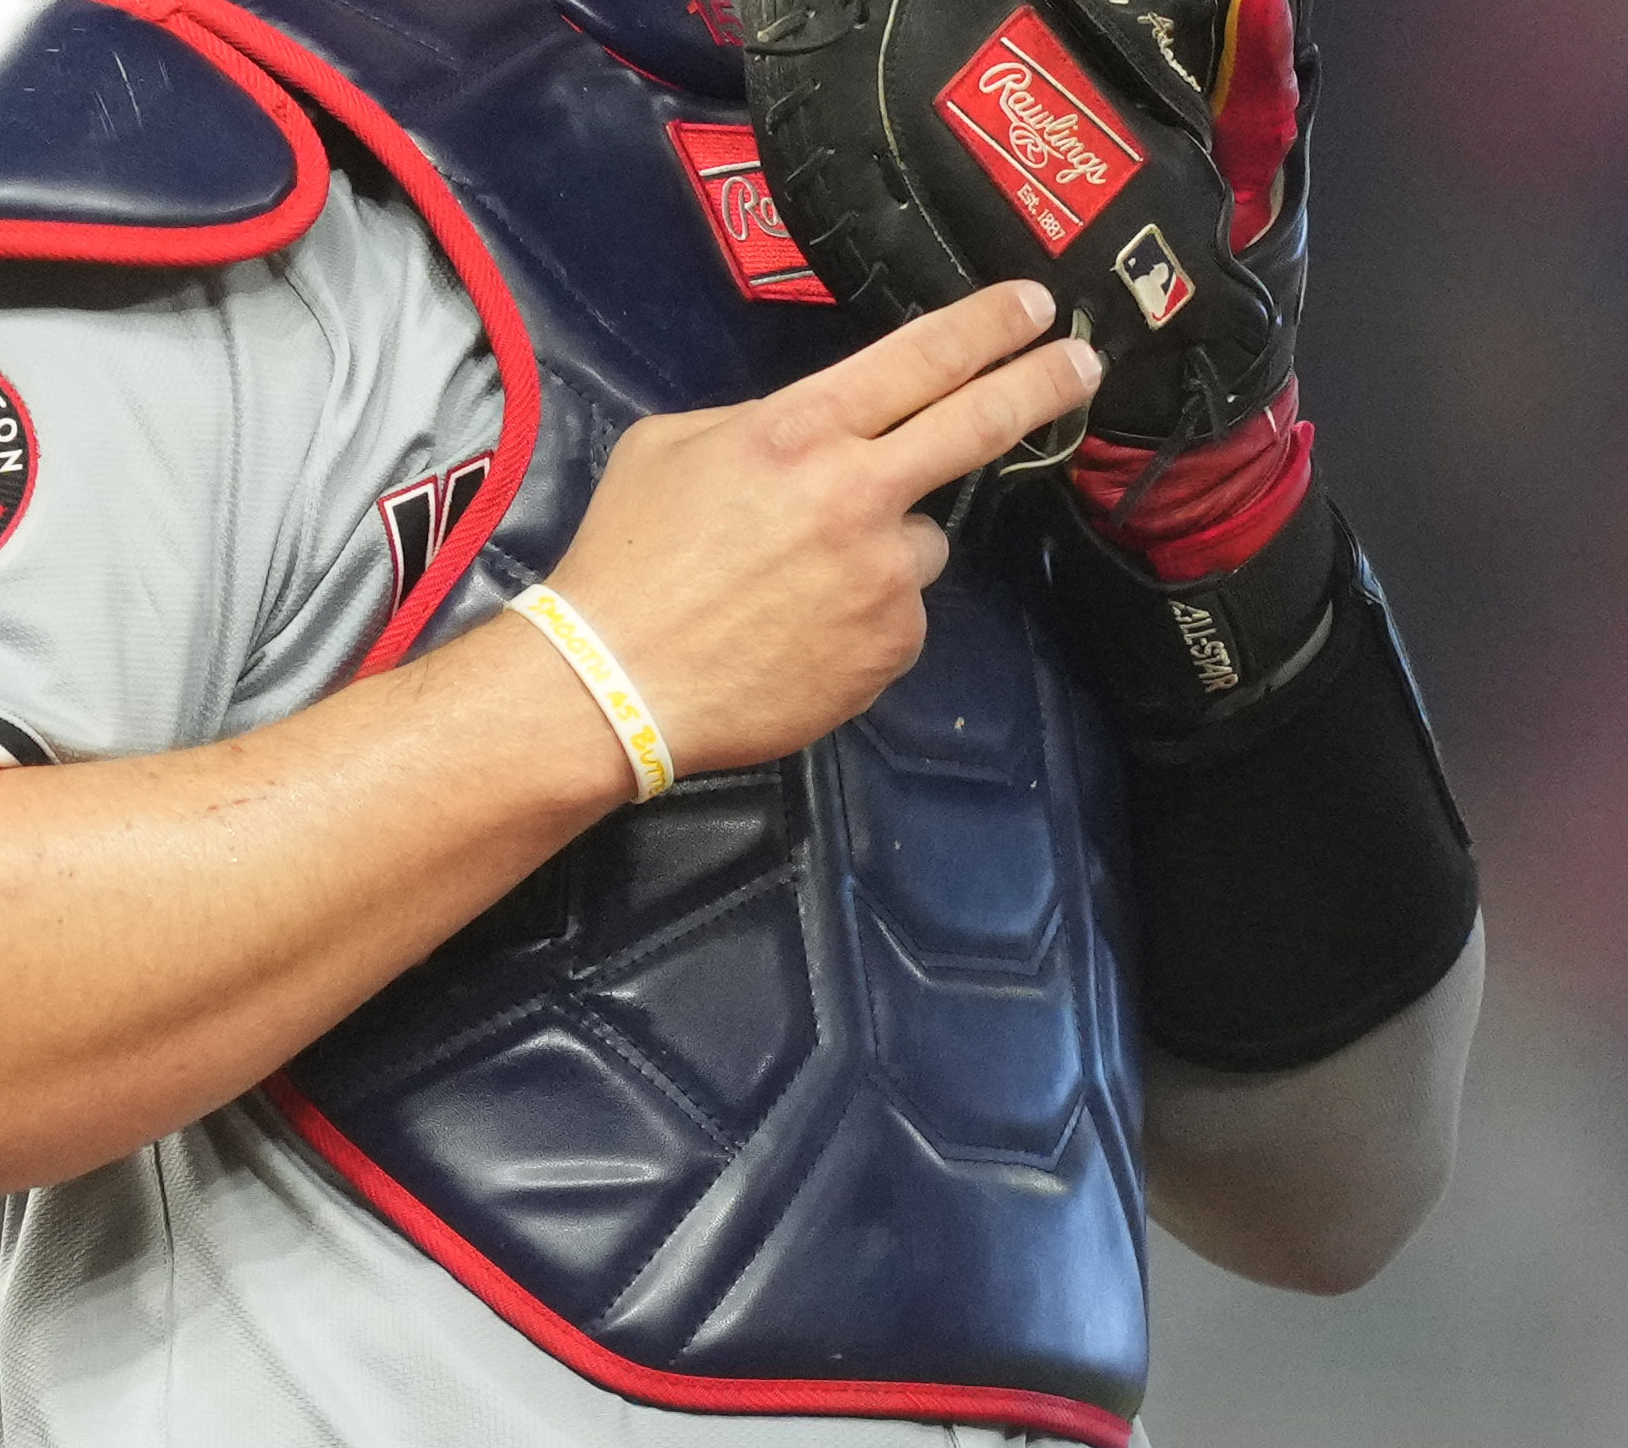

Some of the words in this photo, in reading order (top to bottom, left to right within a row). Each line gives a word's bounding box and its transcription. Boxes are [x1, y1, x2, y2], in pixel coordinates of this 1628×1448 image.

[978, 62, 1109, 185] Rawlings
[1016, 183, 1042, 215] Est.
[1037, 208, 1067, 241] 1887
[528, 596, 613, 681] SMOOTH
[606, 691, 642, 721] AS
[1169, 600, 1239, 693] ALL-STAR
